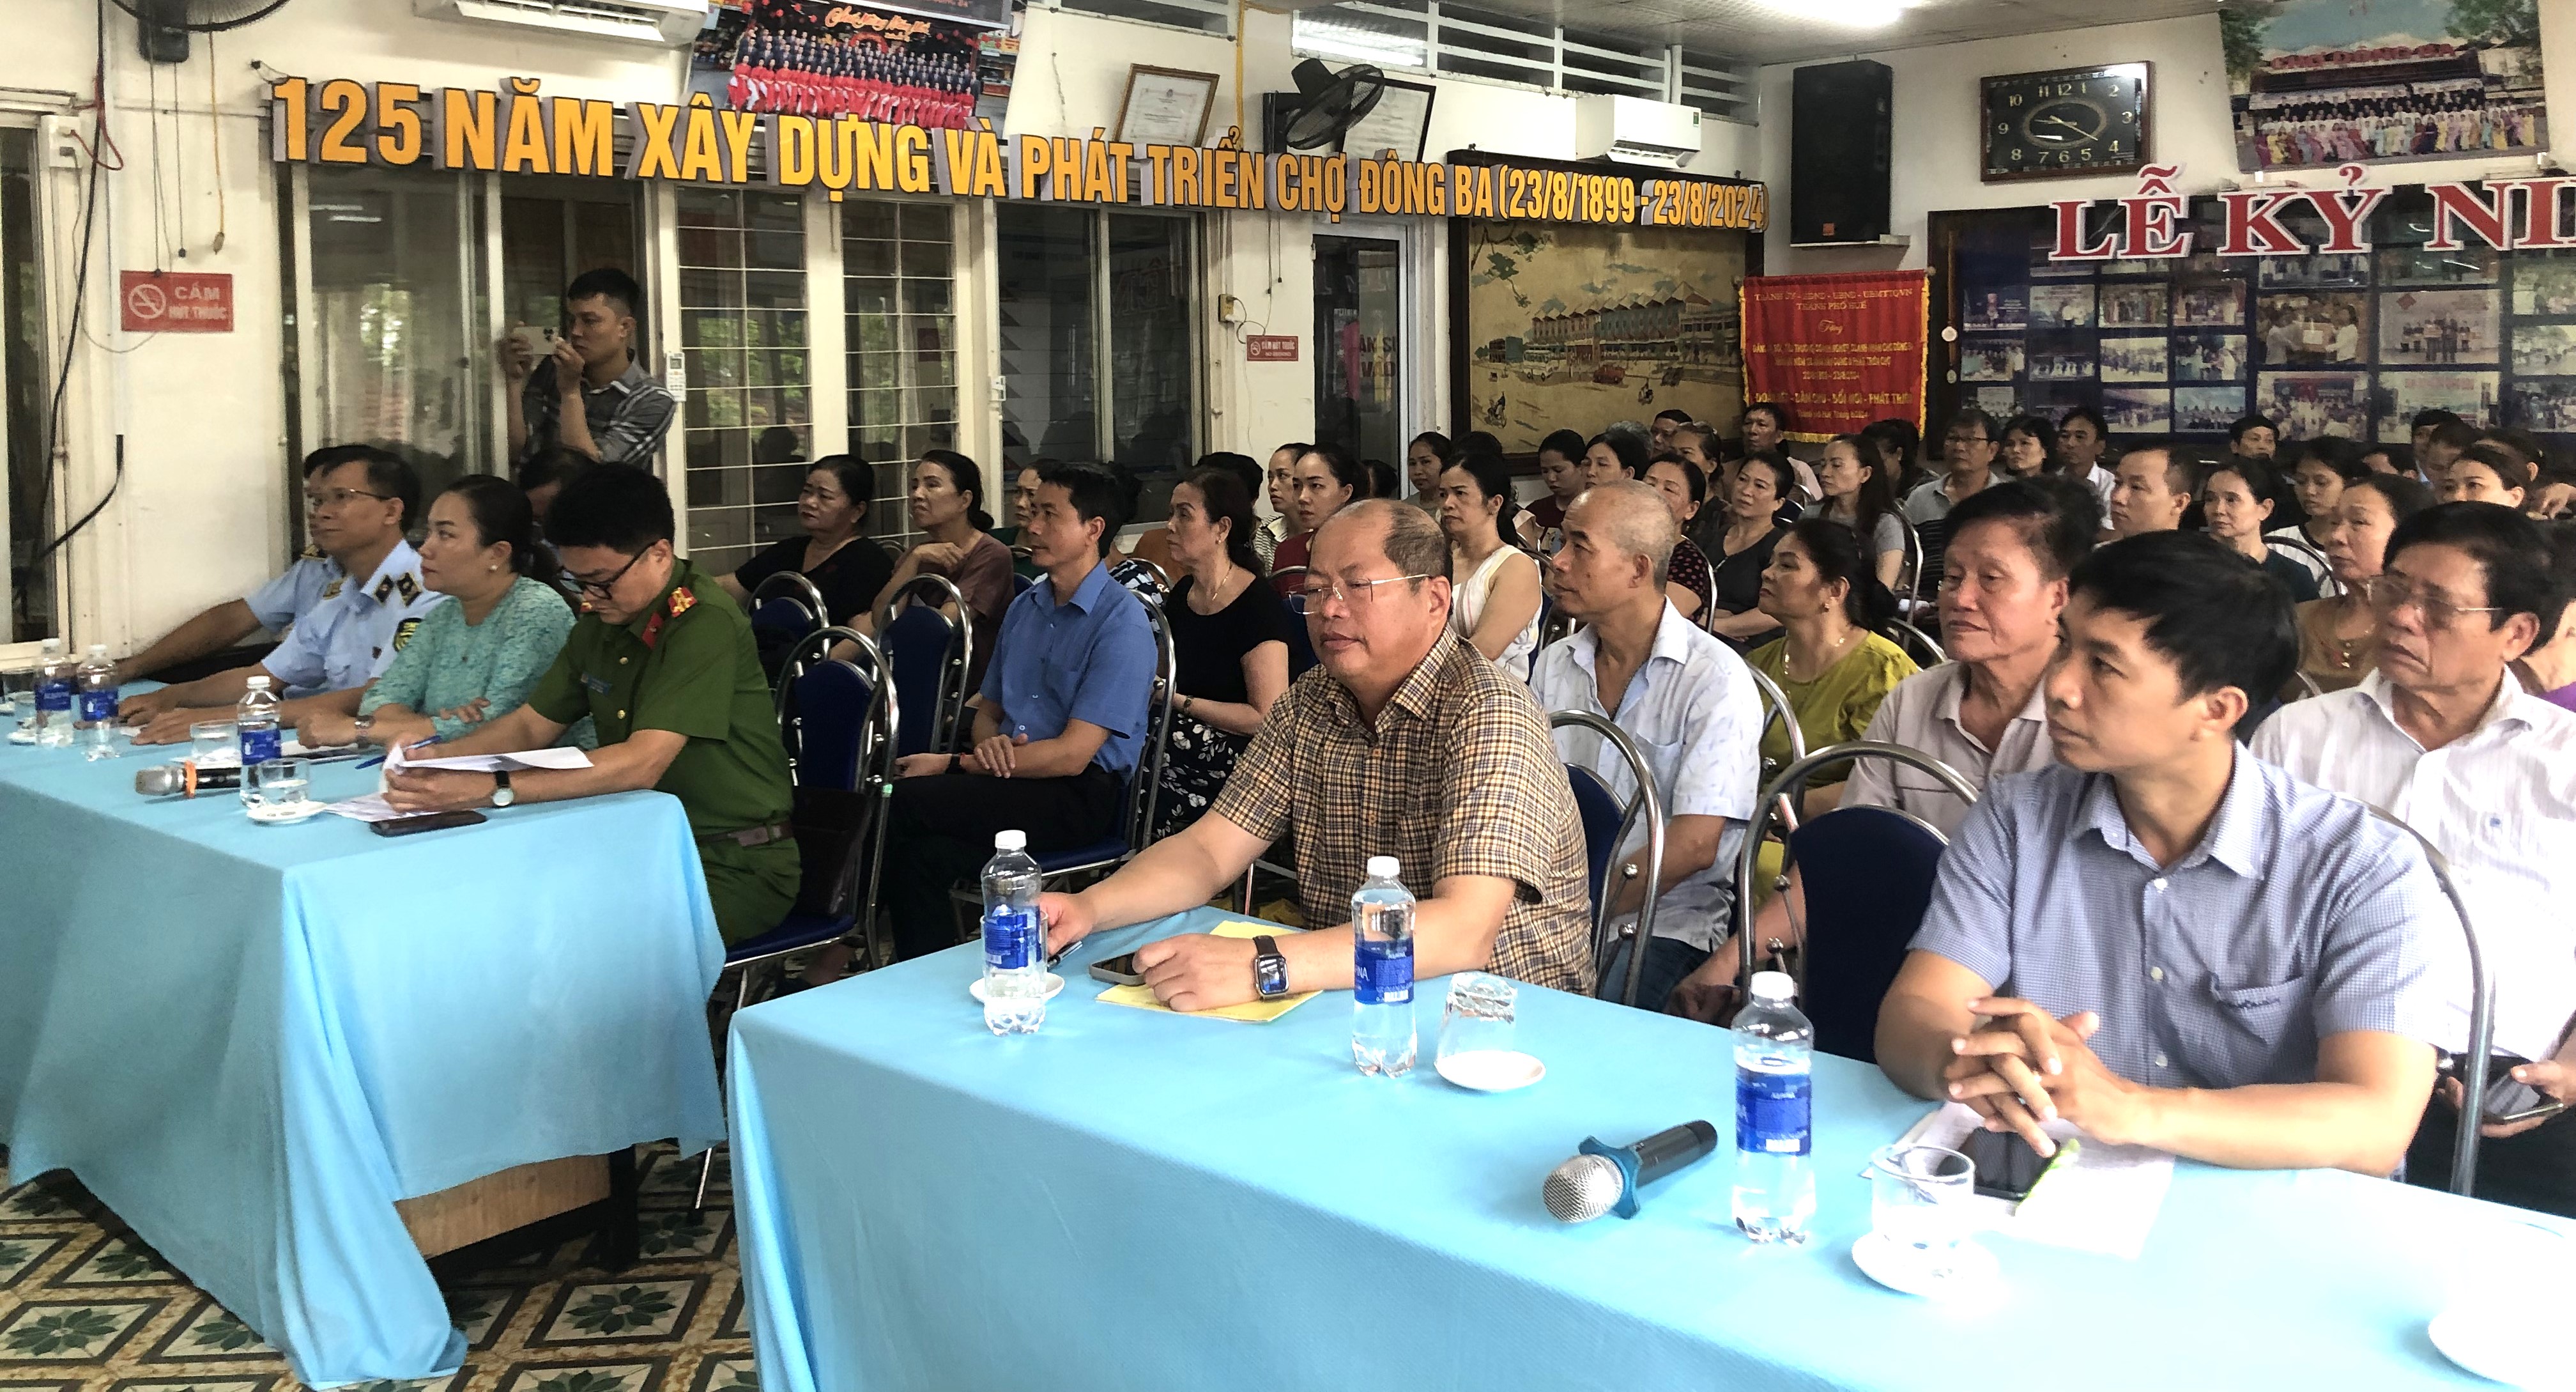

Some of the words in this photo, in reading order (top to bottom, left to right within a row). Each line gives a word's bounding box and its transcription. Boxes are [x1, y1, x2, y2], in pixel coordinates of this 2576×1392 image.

[2038, 85, 2050, 98] 11
[2058, 83, 2072, 96] 12
[2108, 84, 2120, 97] 2
[2009, 94, 2023, 107] 10
[2122, 111, 2133, 124] 3
[1998, 122, 2009, 135] 9
[272, 75, 422, 166] 125
[443, 77, 614, 177] NĂM
[638, 91, 757, 183] XÂY
[777, 113, 931, 203] DỰNG
[944, 117, 1006, 197] VÀ
[1020, 127, 1135, 205] PHÁT
[1147, 125, 1266, 210] TRIỂN
[1276, 152, 1347, 224] CHỢ
[1358, 148, 1446, 216] ĐÔNG
[1453, 164, 1494, 218] BA
[1499, 164, 1635, 224] (23/8/1899
[2109, 140, 2119, 153] 4
[2011, 148, 2022, 161] 8
[2038, 151, 2050, 164] 7
[2058, 150, 2071, 163] 6
[2081, 148, 2092, 161] 5
[2048, 162, 2190, 260] LỄ
[2217, 164, 2393, 255] KỶ
[2423, 176, 2576, 251] NI
[174, 281, 220, 300] CẤM
